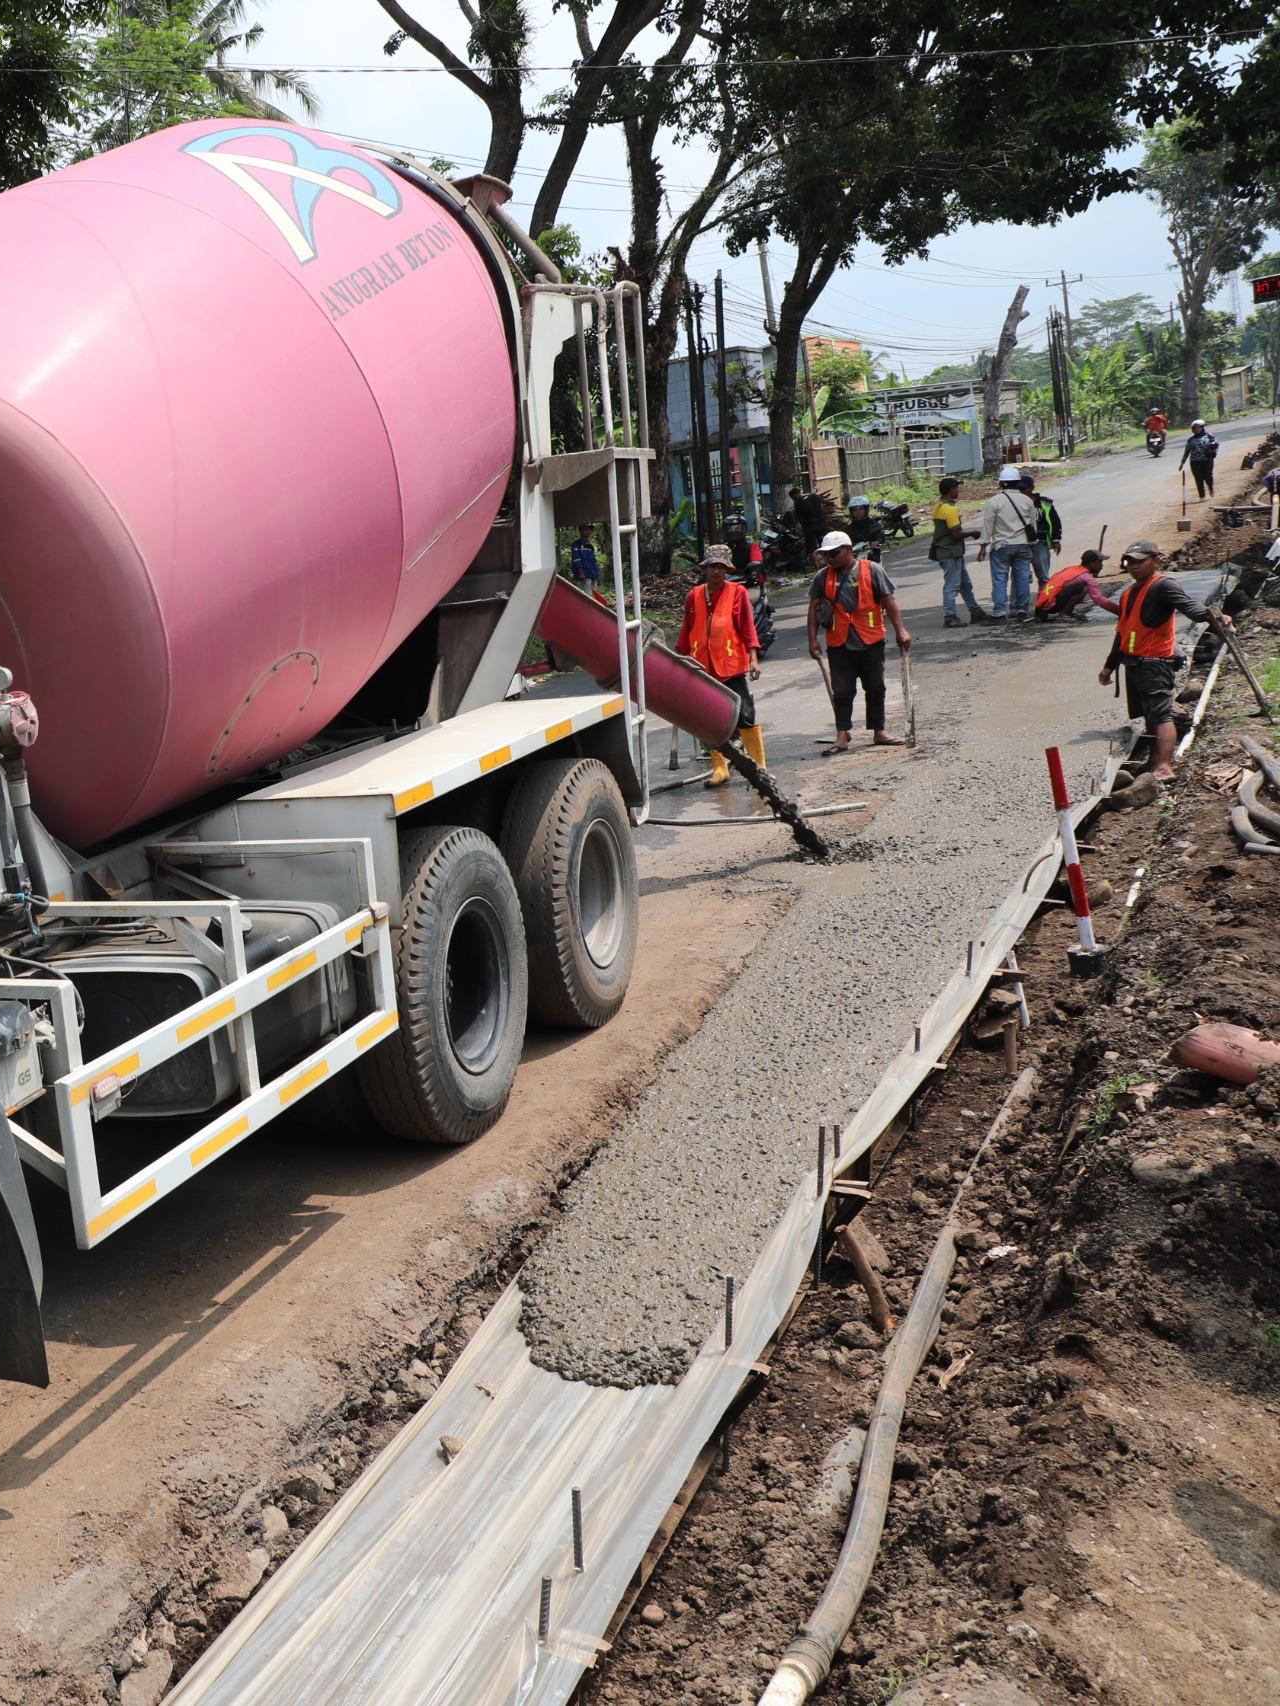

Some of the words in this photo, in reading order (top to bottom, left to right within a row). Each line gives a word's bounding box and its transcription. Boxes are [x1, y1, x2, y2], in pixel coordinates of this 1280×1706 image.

[320, 252, 406, 321] ANUGRAH
[396, 221, 457, 271] BETON
[18, 1068, 32, 1086] GS
